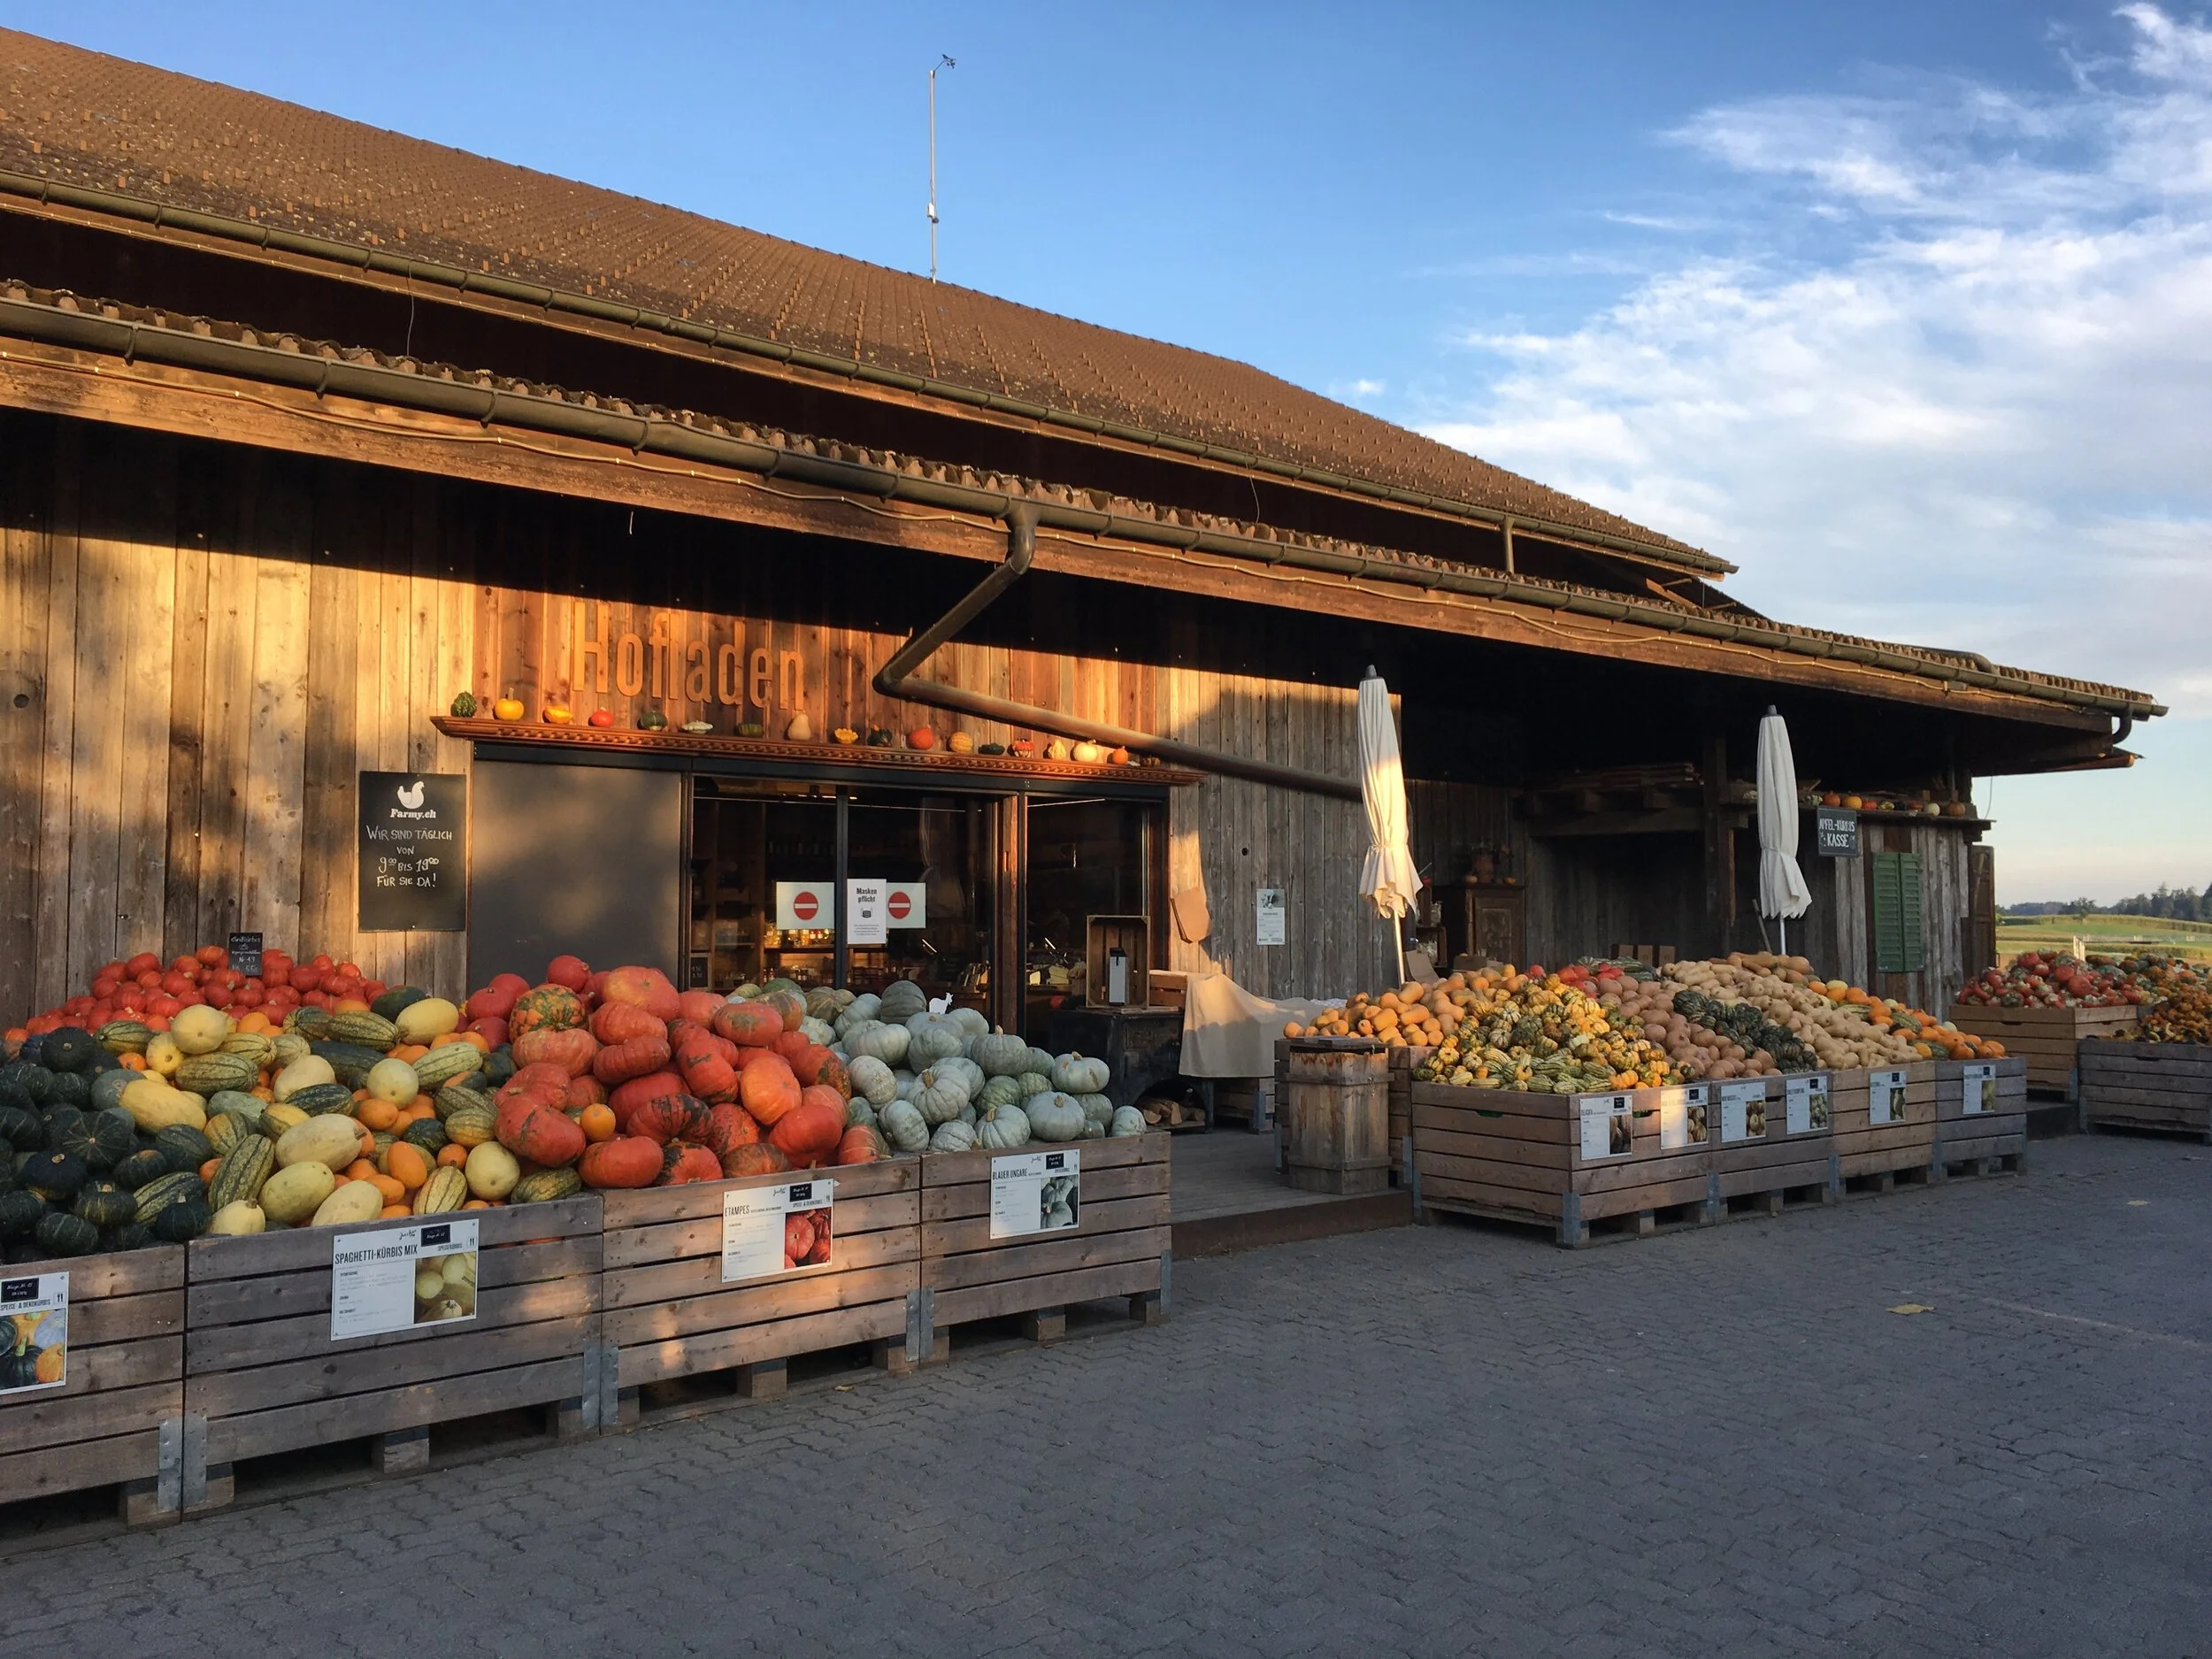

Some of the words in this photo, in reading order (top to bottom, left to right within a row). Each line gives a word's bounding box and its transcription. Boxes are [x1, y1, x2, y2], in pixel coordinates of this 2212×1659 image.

[573, 601, 805, 711] Hofladen
[389, 808, 436, 820] Farmy.ch
[365, 825, 389, 841] WIR
[390, 829, 413, 841] SIND
[414, 827, 453, 841] TÄGLICH
[1826, 833, 1849, 848] KASSE
[396, 846, 415, 855] VON
[397, 862, 413, 872] BIS
[376, 874, 396, 887] FÜR
[399, 877, 413, 886] SIE
[992, 1170, 1010, 1180] BLAUER
[725, 1204, 750, 1217] ETAMPES
[334, 1246, 403, 1265] SPAGHETTI-KÜRBIS
[403, 1244, 419, 1256] MIX
